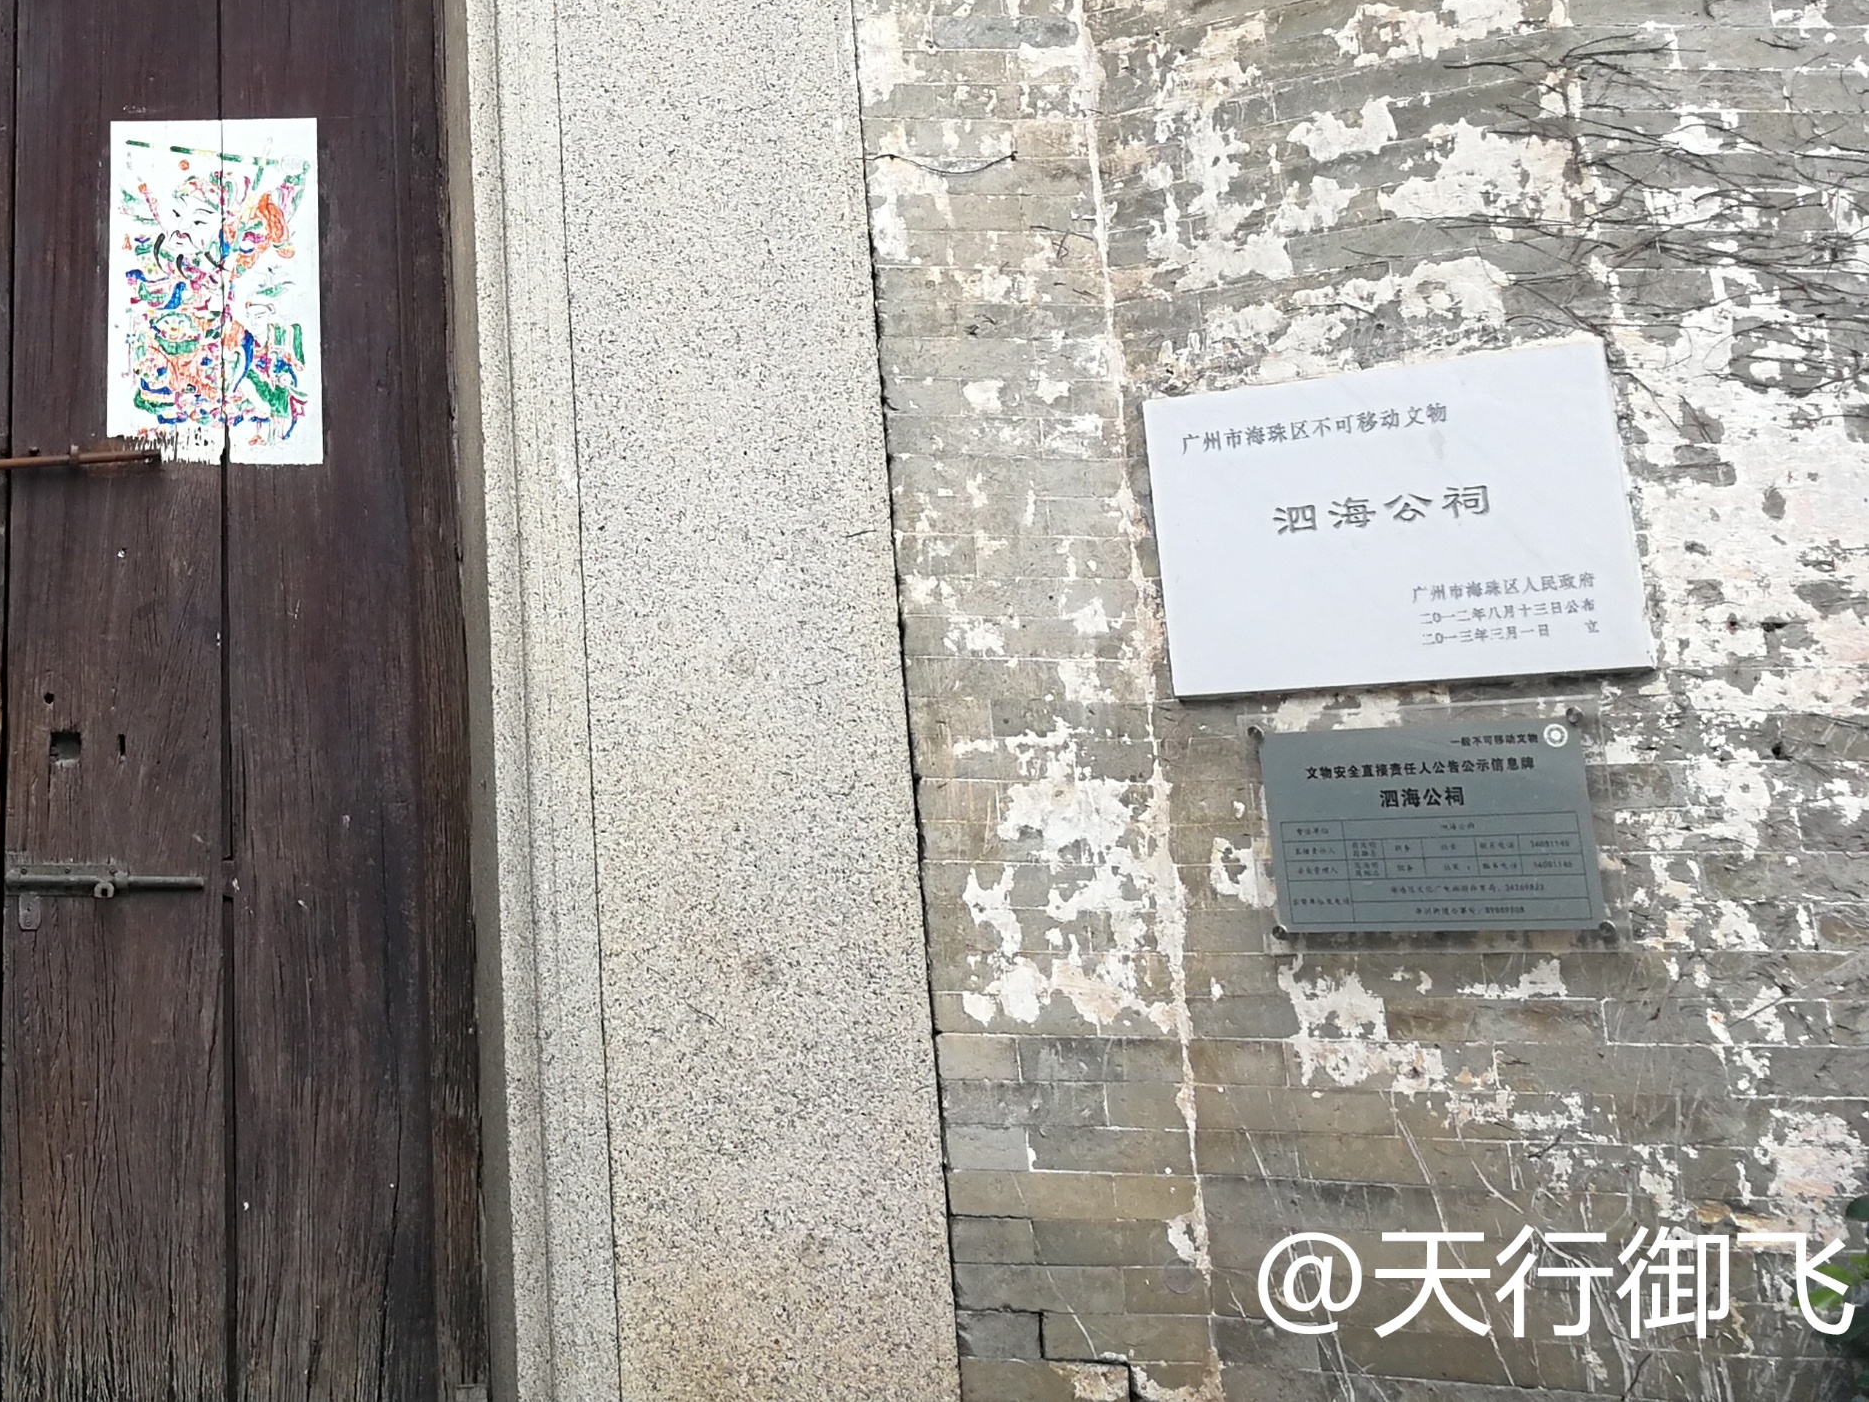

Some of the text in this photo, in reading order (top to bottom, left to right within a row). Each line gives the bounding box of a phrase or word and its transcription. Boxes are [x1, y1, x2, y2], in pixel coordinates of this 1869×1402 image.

[1182, 402, 1447, 455] 广州市海珠区不可移动文物
[1273, 484, 1491, 535] 泗海公祠
[1412, 571, 1595, 603] 广州市海珠区人民政府
[1305, 756, 1535, 781] 文物安全直接责任人公告公示信息牌
[1379, 786, 1465, 808] 泗海公祠
